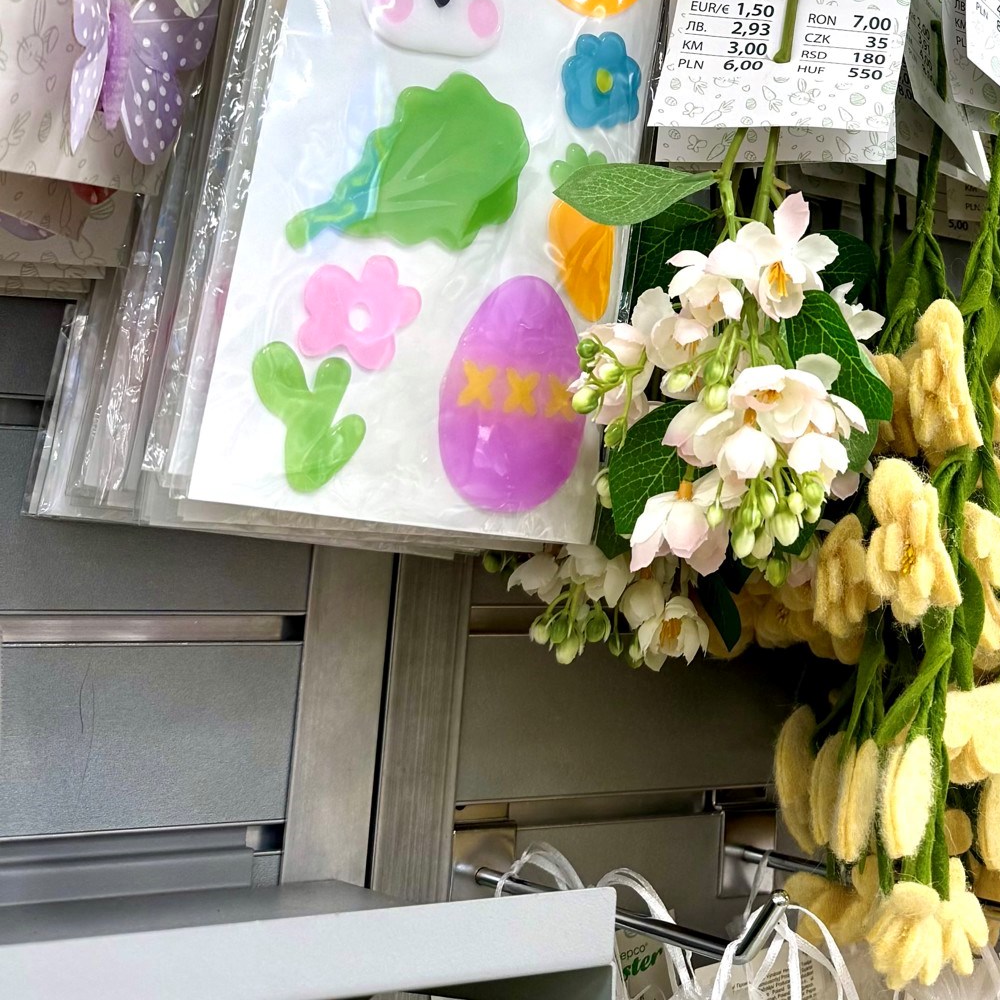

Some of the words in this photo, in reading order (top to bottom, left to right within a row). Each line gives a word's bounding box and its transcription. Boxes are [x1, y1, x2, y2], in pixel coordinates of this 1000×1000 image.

[690, 1, 729, 15] EUR/€
[736, 2, 775, 18] 1,50
[975, 1, 989, 20] PLN
[731, 21, 771, 37] 2,93
[808, 13, 837, 26] RON
[853, 15, 892, 32] 7,00
[682, 39, 704, 52] KM
[727, 41, 768, 57] 3,00
[804, 33, 831, 44] CZK
[866, 36, 888, 49] 35
[678, 58, 705, 70] PLN
[723, 60, 764, 73] 6,00
[801, 50, 828, 60] RSD
[853, 52, 886, 66] 180
[797, 65, 825, 75] HUF
[848, 67, 883, 81] 550
[948, 219, 969, 231] 5,00
[620, 943, 648, 961] epco
[622, 948, 663, 981] ster
